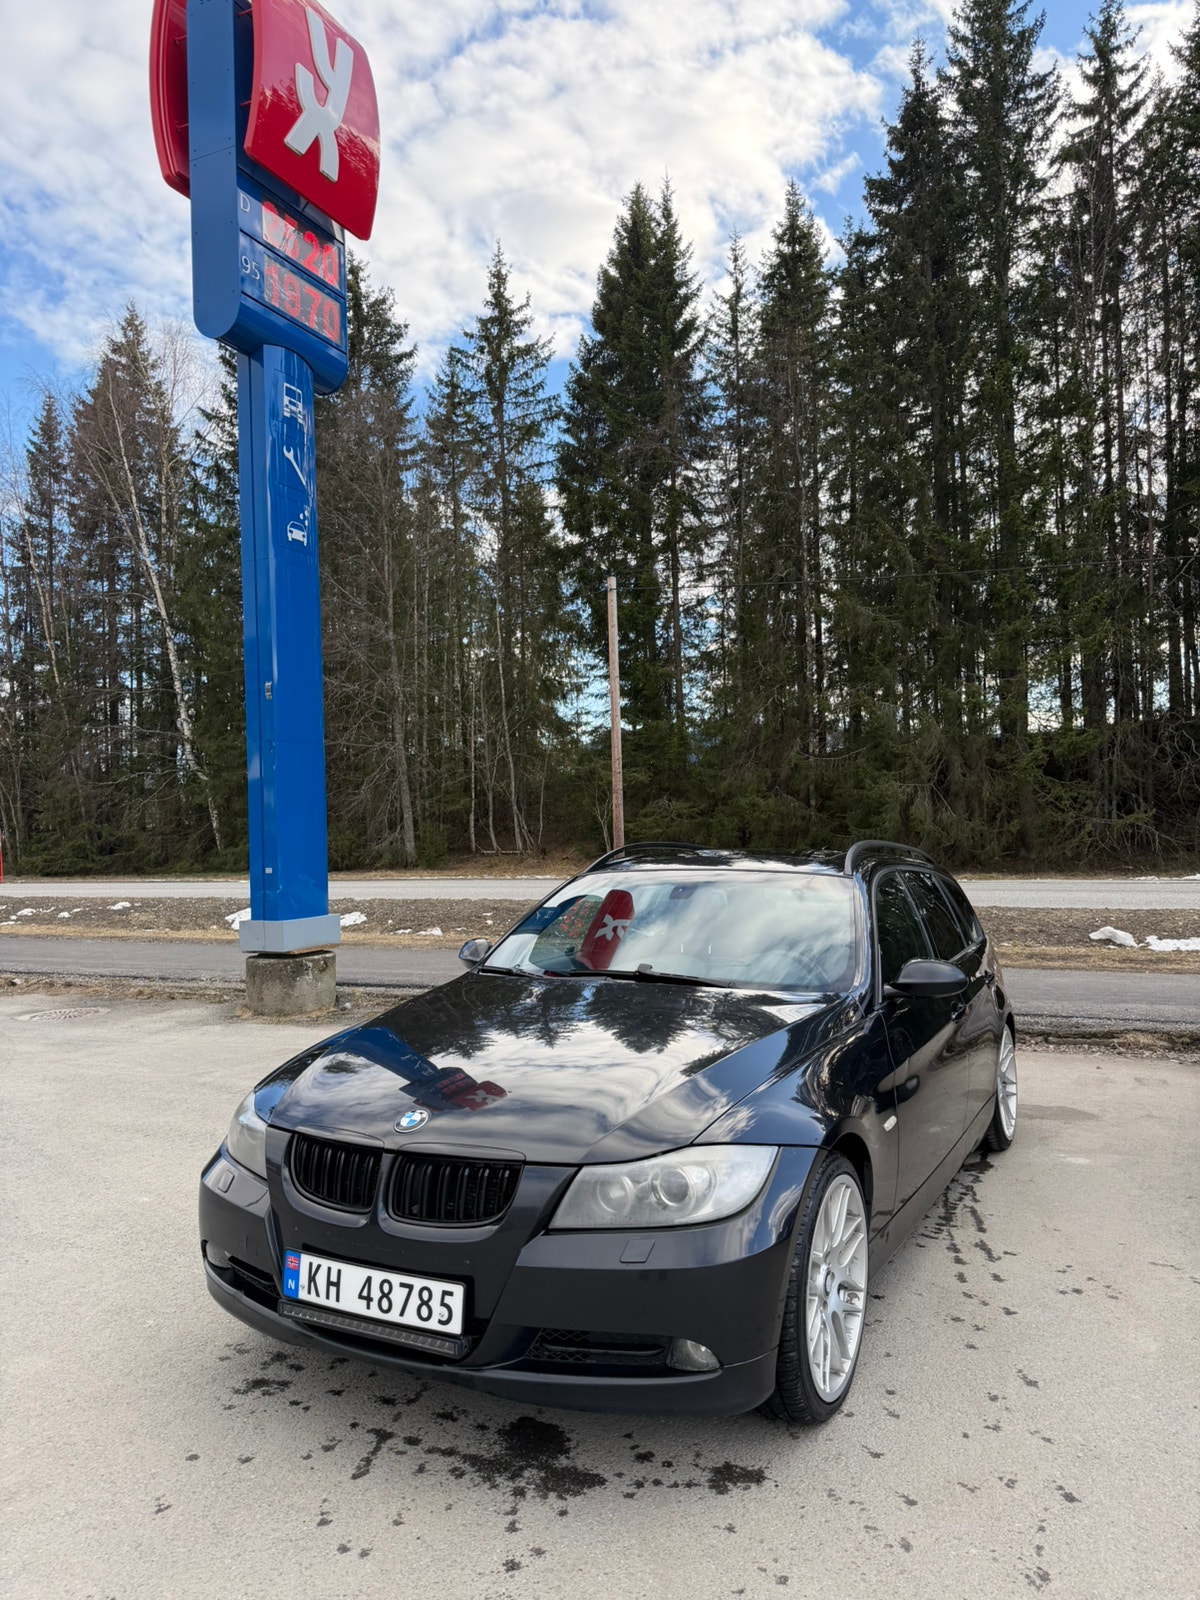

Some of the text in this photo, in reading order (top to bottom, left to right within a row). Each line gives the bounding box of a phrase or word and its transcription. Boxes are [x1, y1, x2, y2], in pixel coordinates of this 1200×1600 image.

[240, 192, 251, 213] D
[241, 256, 260, 280] 95
[287, 1279, 295, 1290] N
[307, 1261, 454, 1326] KH 48785
